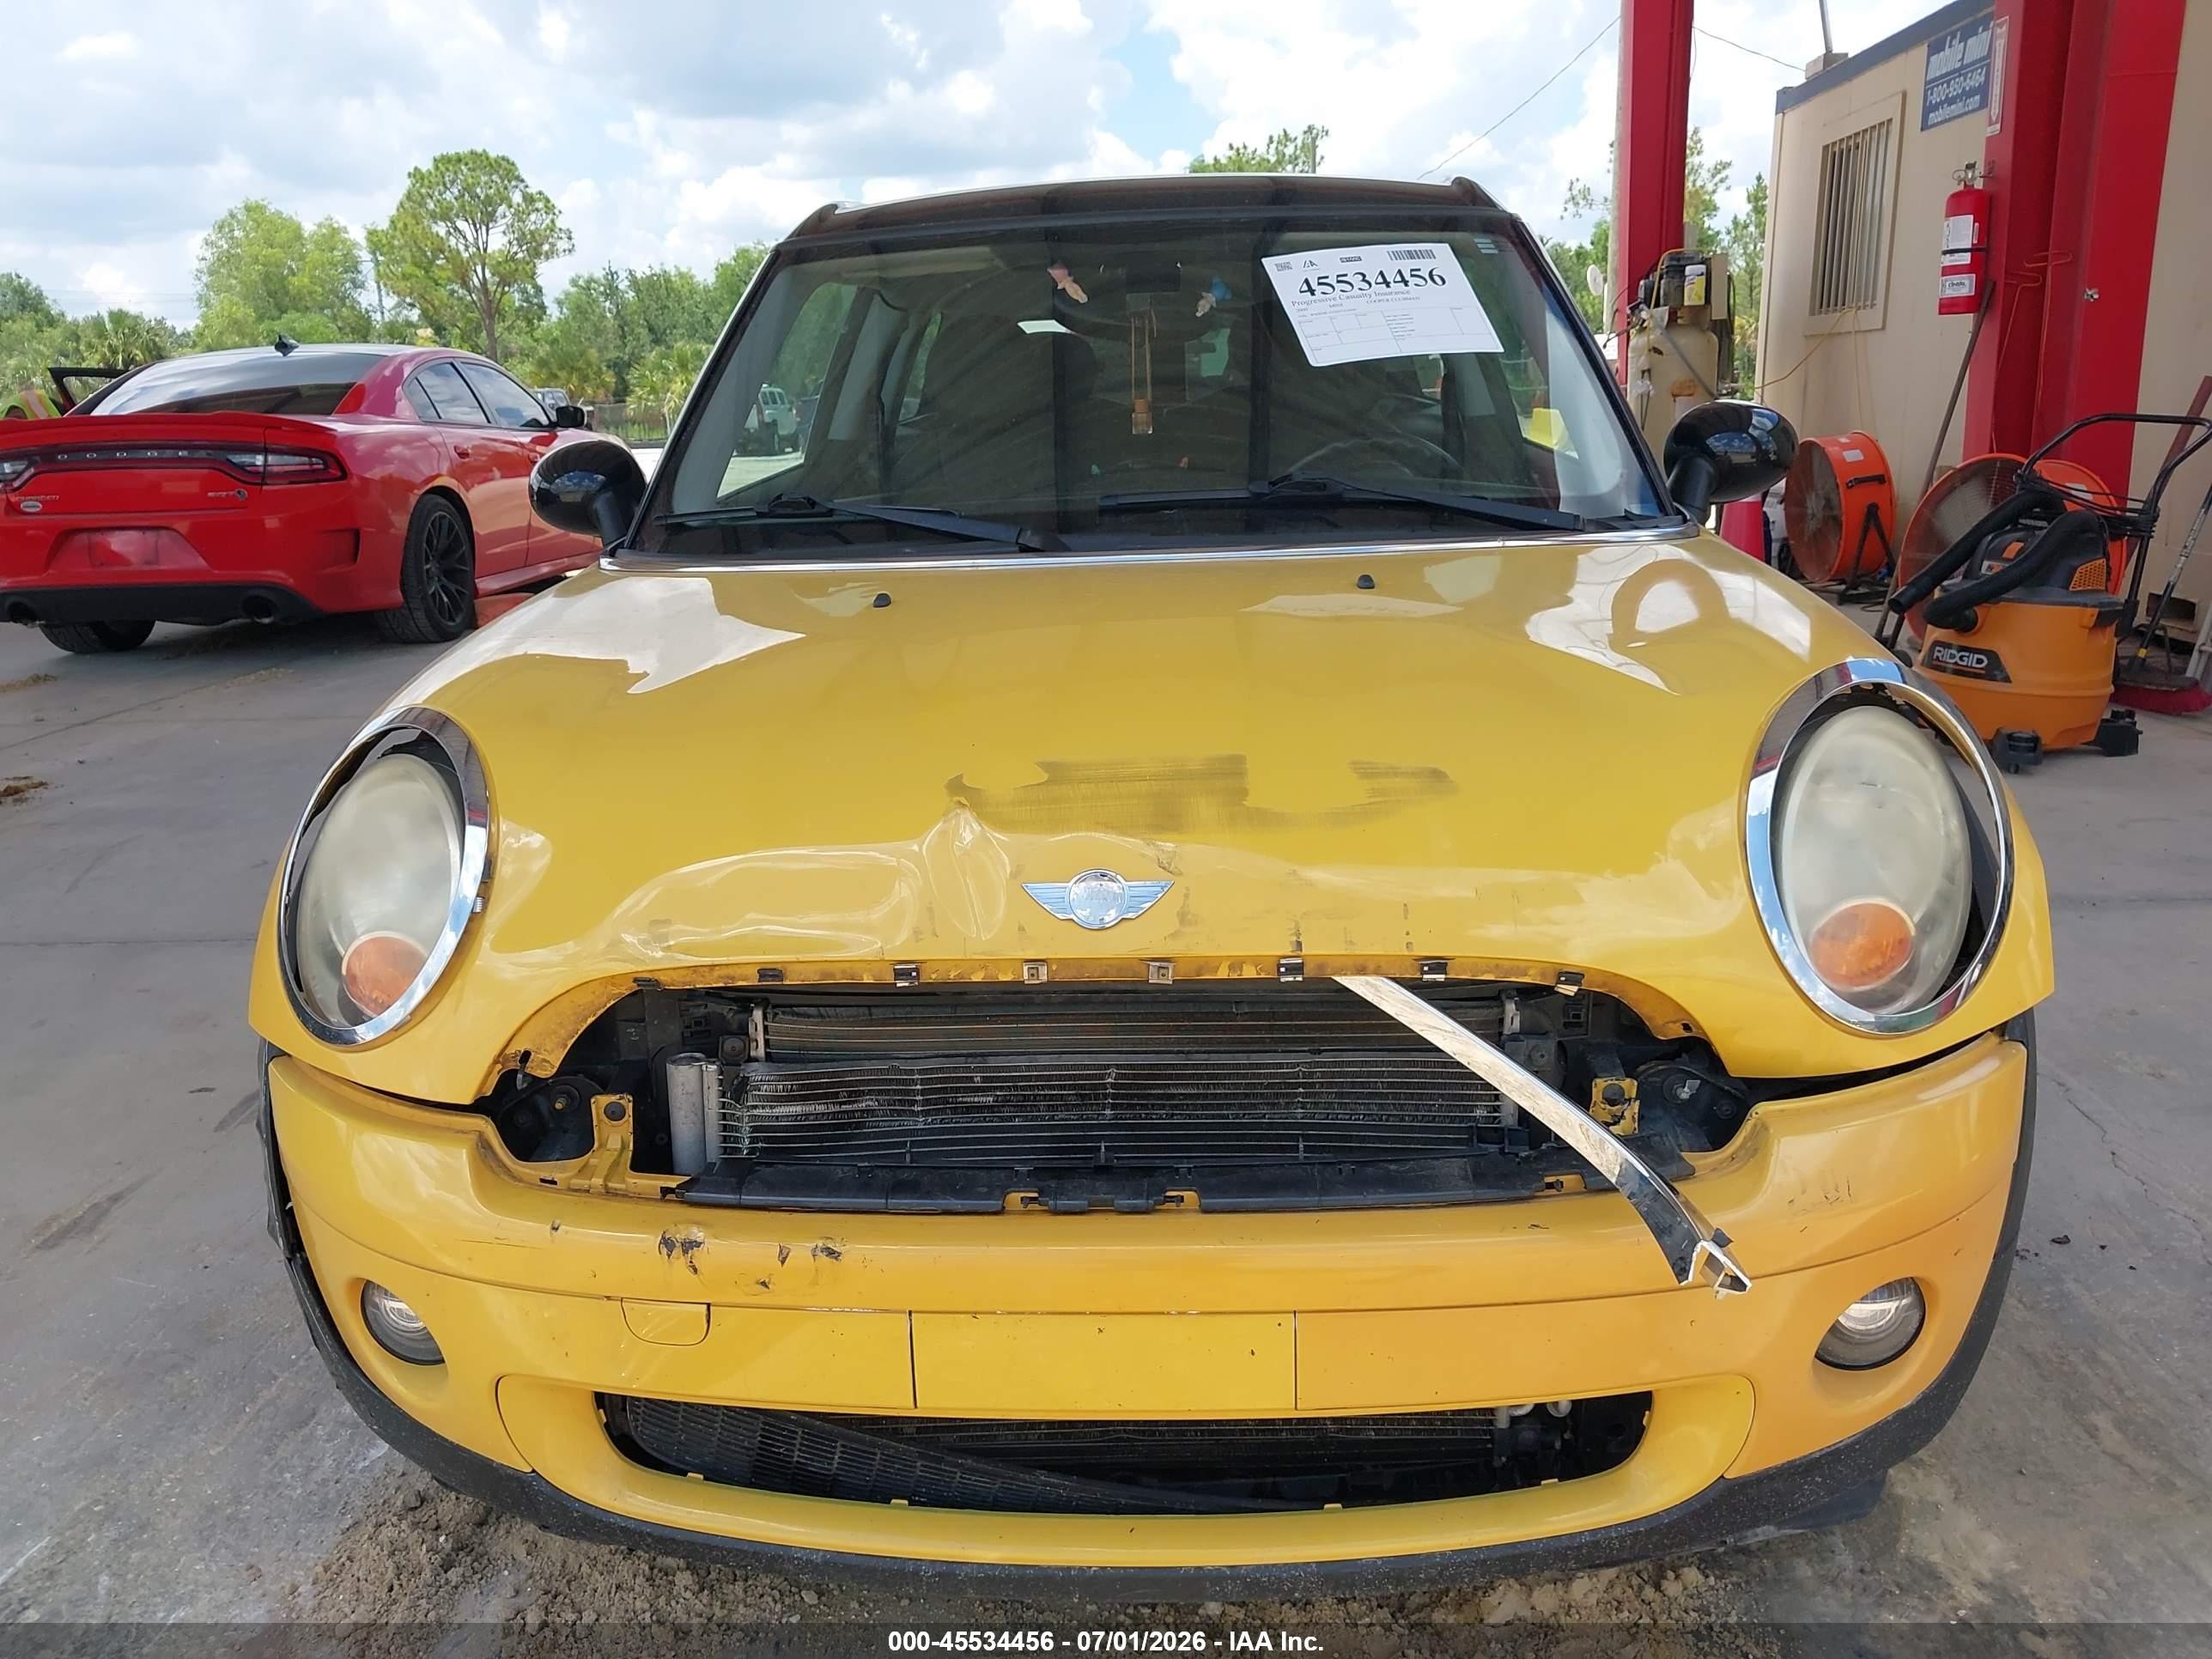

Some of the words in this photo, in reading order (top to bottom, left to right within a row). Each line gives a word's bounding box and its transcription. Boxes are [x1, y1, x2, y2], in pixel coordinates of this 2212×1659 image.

[1927, 31, 1965, 80] mobile
[1963, 21, 1993, 64] mini
[1928, 94, 1980, 125] mobilemini.com
[1298, 267, 1447, 296] 45534456
[1291, 297, 1337, 307] Progressive
[1339, 292, 1372, 301] Casualty
[1933, 646, 1988, 668] RIDGID
